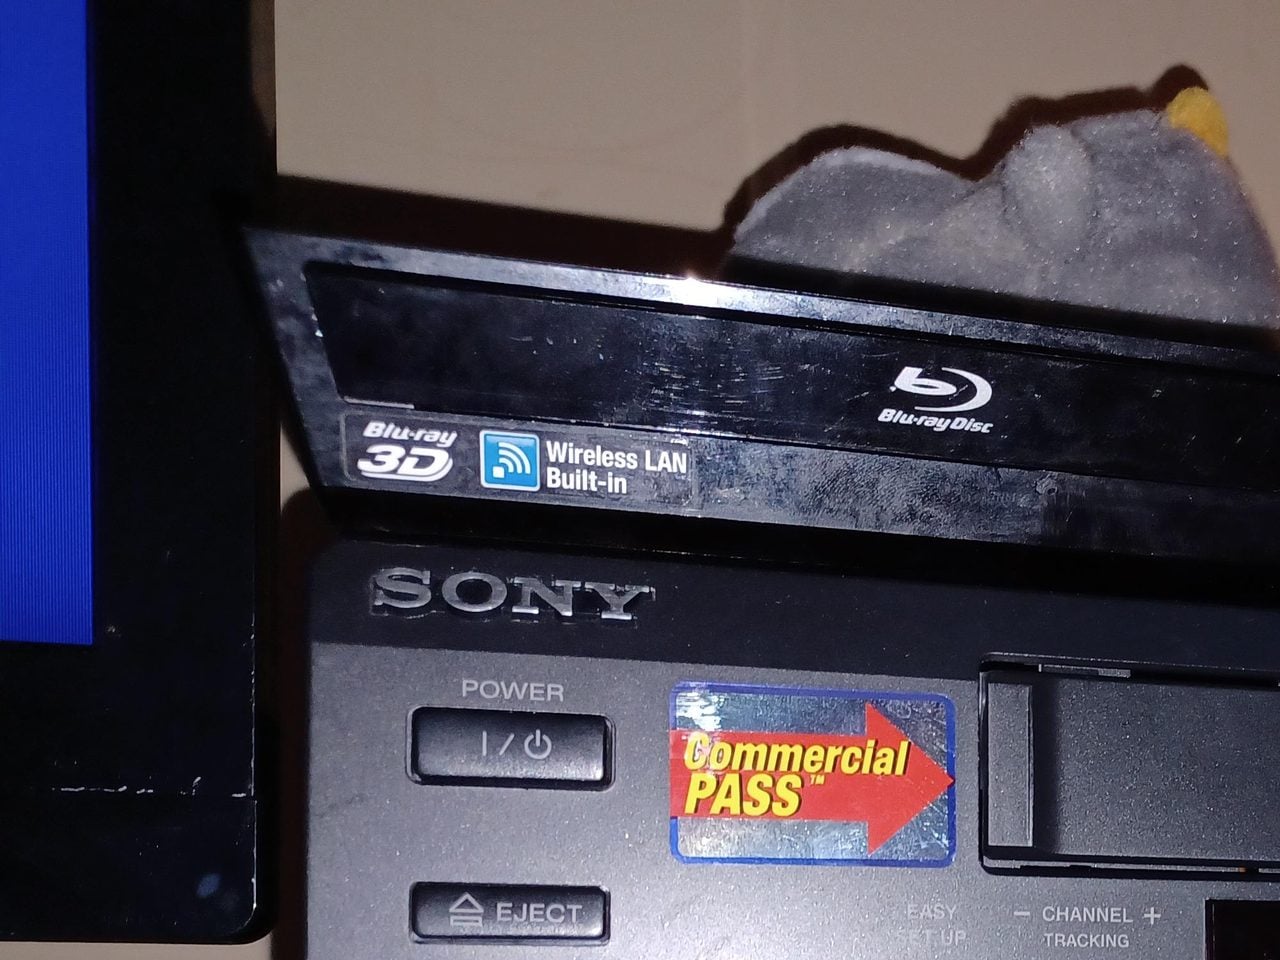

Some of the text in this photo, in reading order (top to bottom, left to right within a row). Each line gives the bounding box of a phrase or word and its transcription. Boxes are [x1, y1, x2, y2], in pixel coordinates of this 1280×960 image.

[949, 417, 993, 433] Disc
[357, 444, 453, 482] 3D
[546, 440, 688, 474] Wireless LAN
[546, 466, 628, 495] Built-in
[374, 566, 655, 622] SONY
[462, 679, 564, 702] POWER
[684, 731, 911, 777] Commercial
[684, 771, 803, 817] PASS
[496, 902, 583, 923] EJECT
[907, 903, 956, 920] EASY
[1042, 905, 1134, 923] CHANNEL
[1044, 932, 1130, 949] TRACKING
